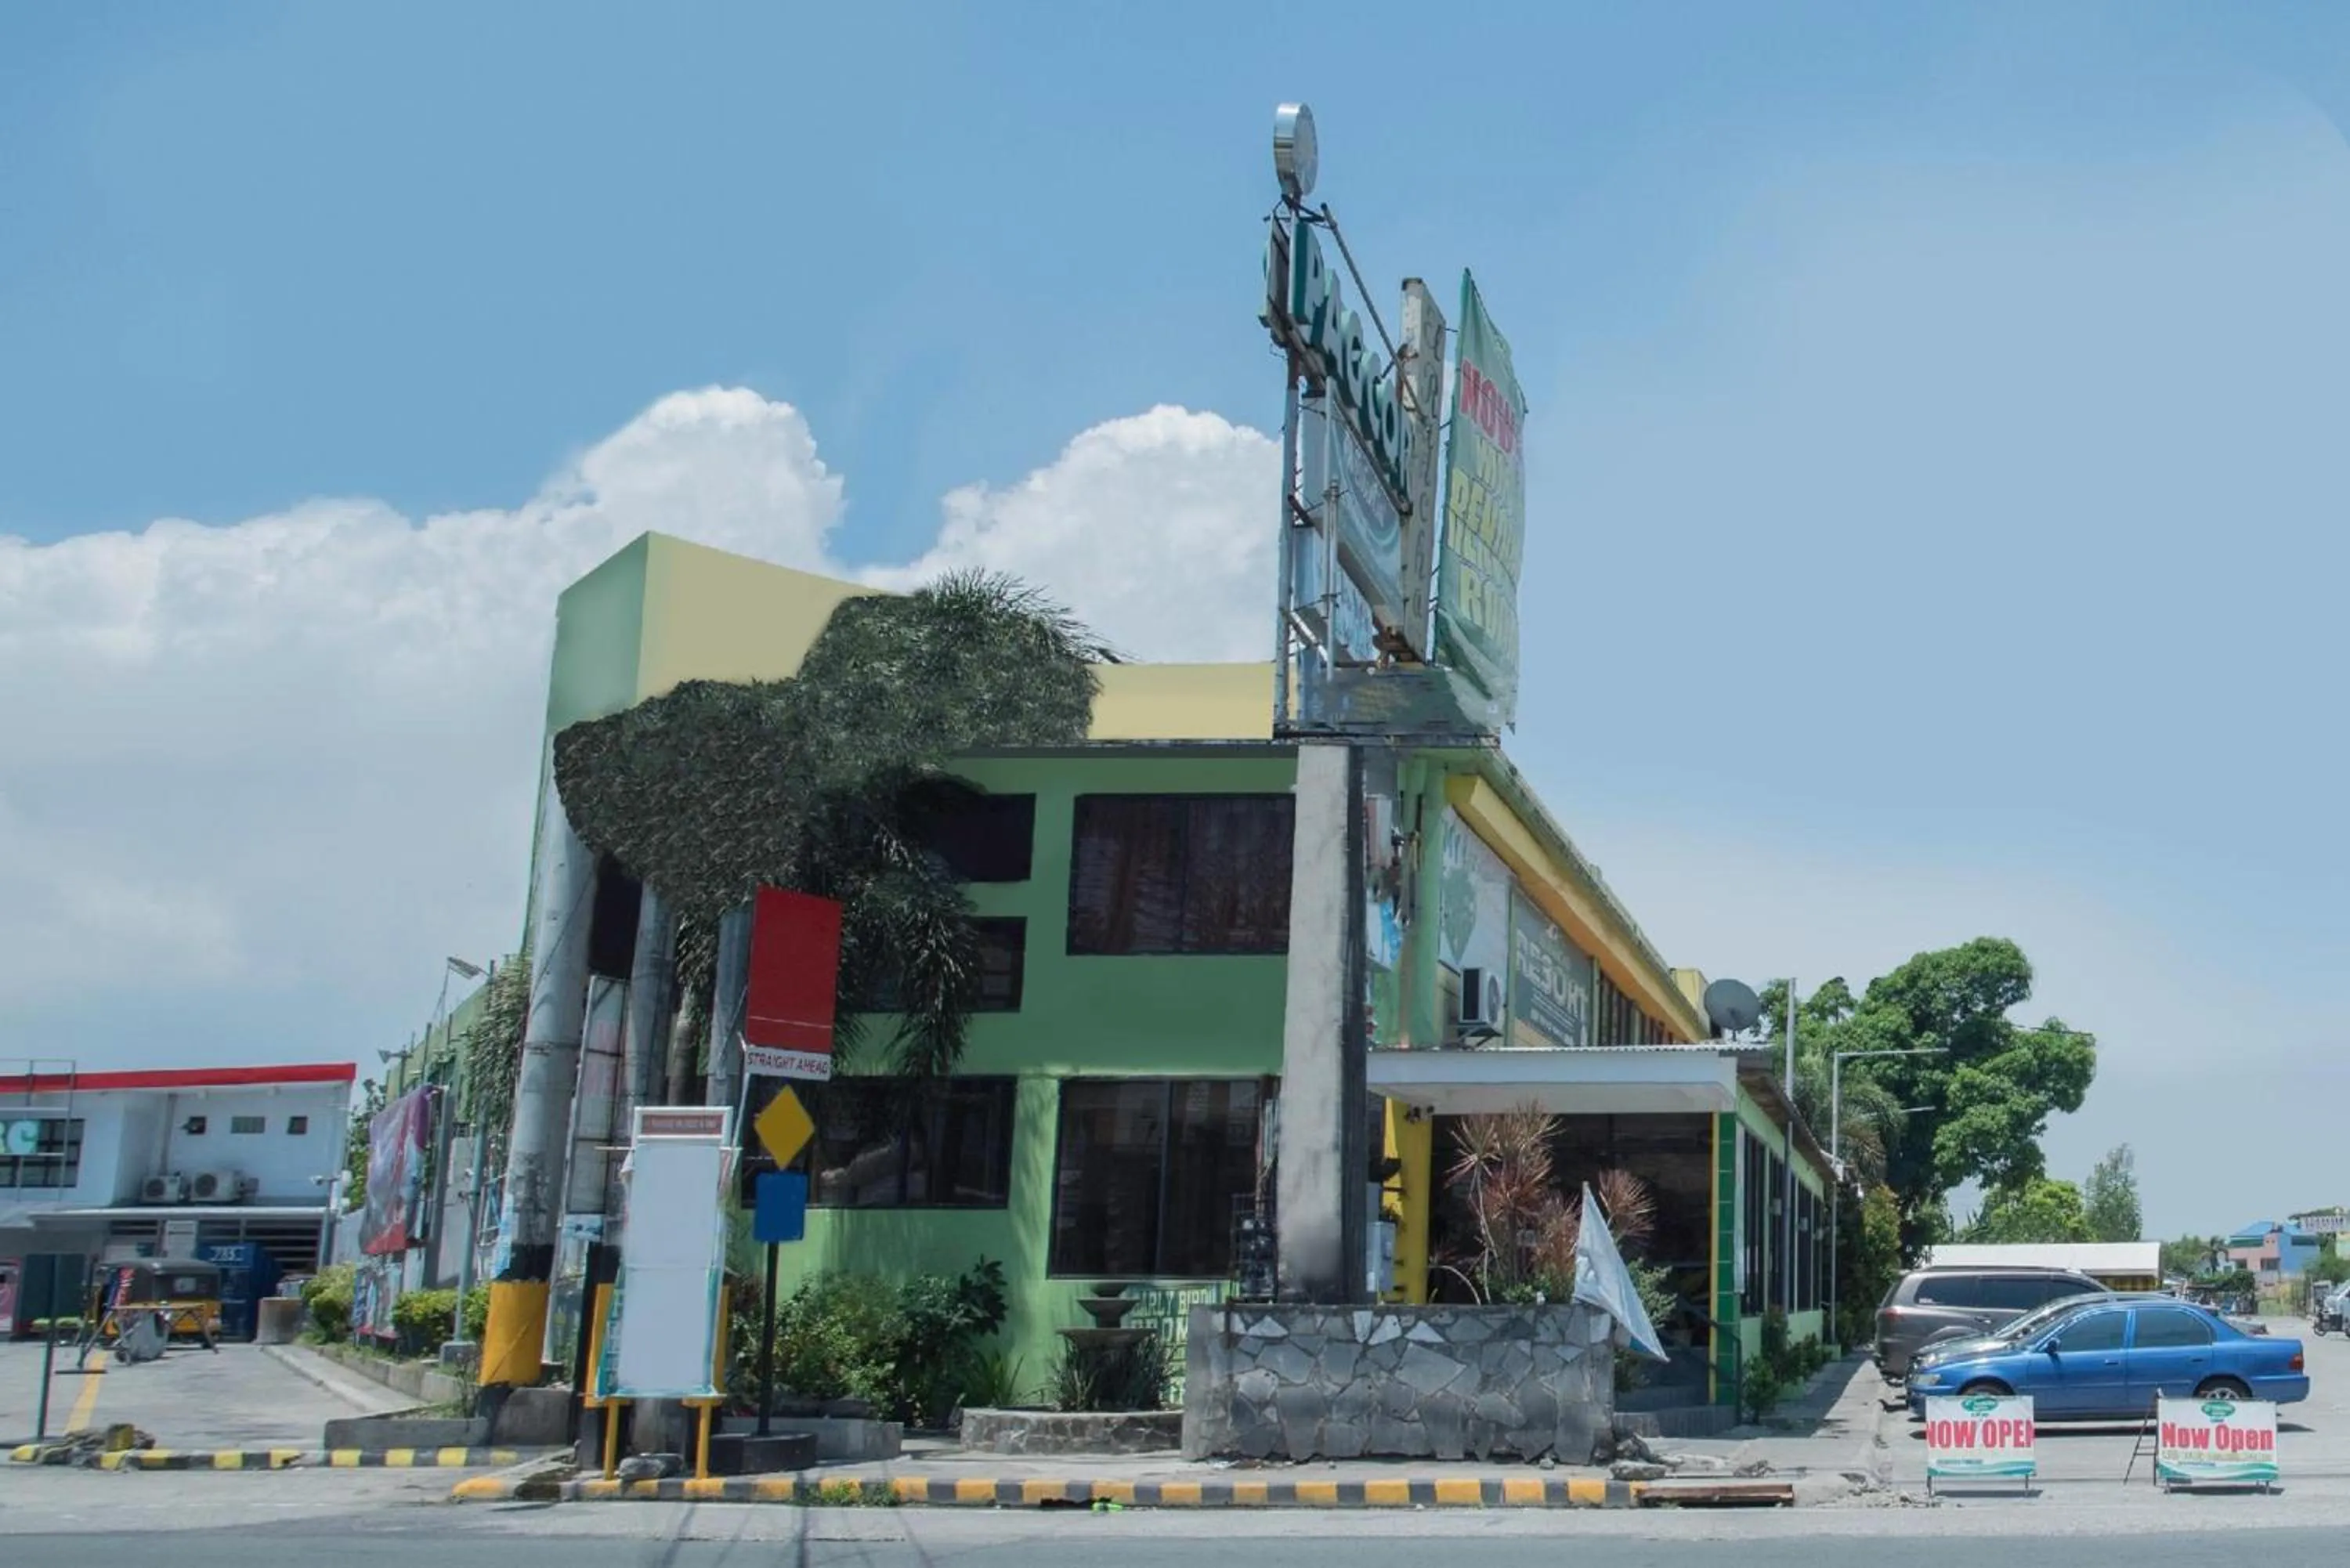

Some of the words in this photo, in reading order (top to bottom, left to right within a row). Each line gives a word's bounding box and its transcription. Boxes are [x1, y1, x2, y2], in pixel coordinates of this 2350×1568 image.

[747, 1051, 797, 1069] STRAIGHT
[796, 1057, 829, 1075] AHEAD
[2162, 1422, 2210, 1450] Now
[2215, 1424, 2273, 1452] Open
